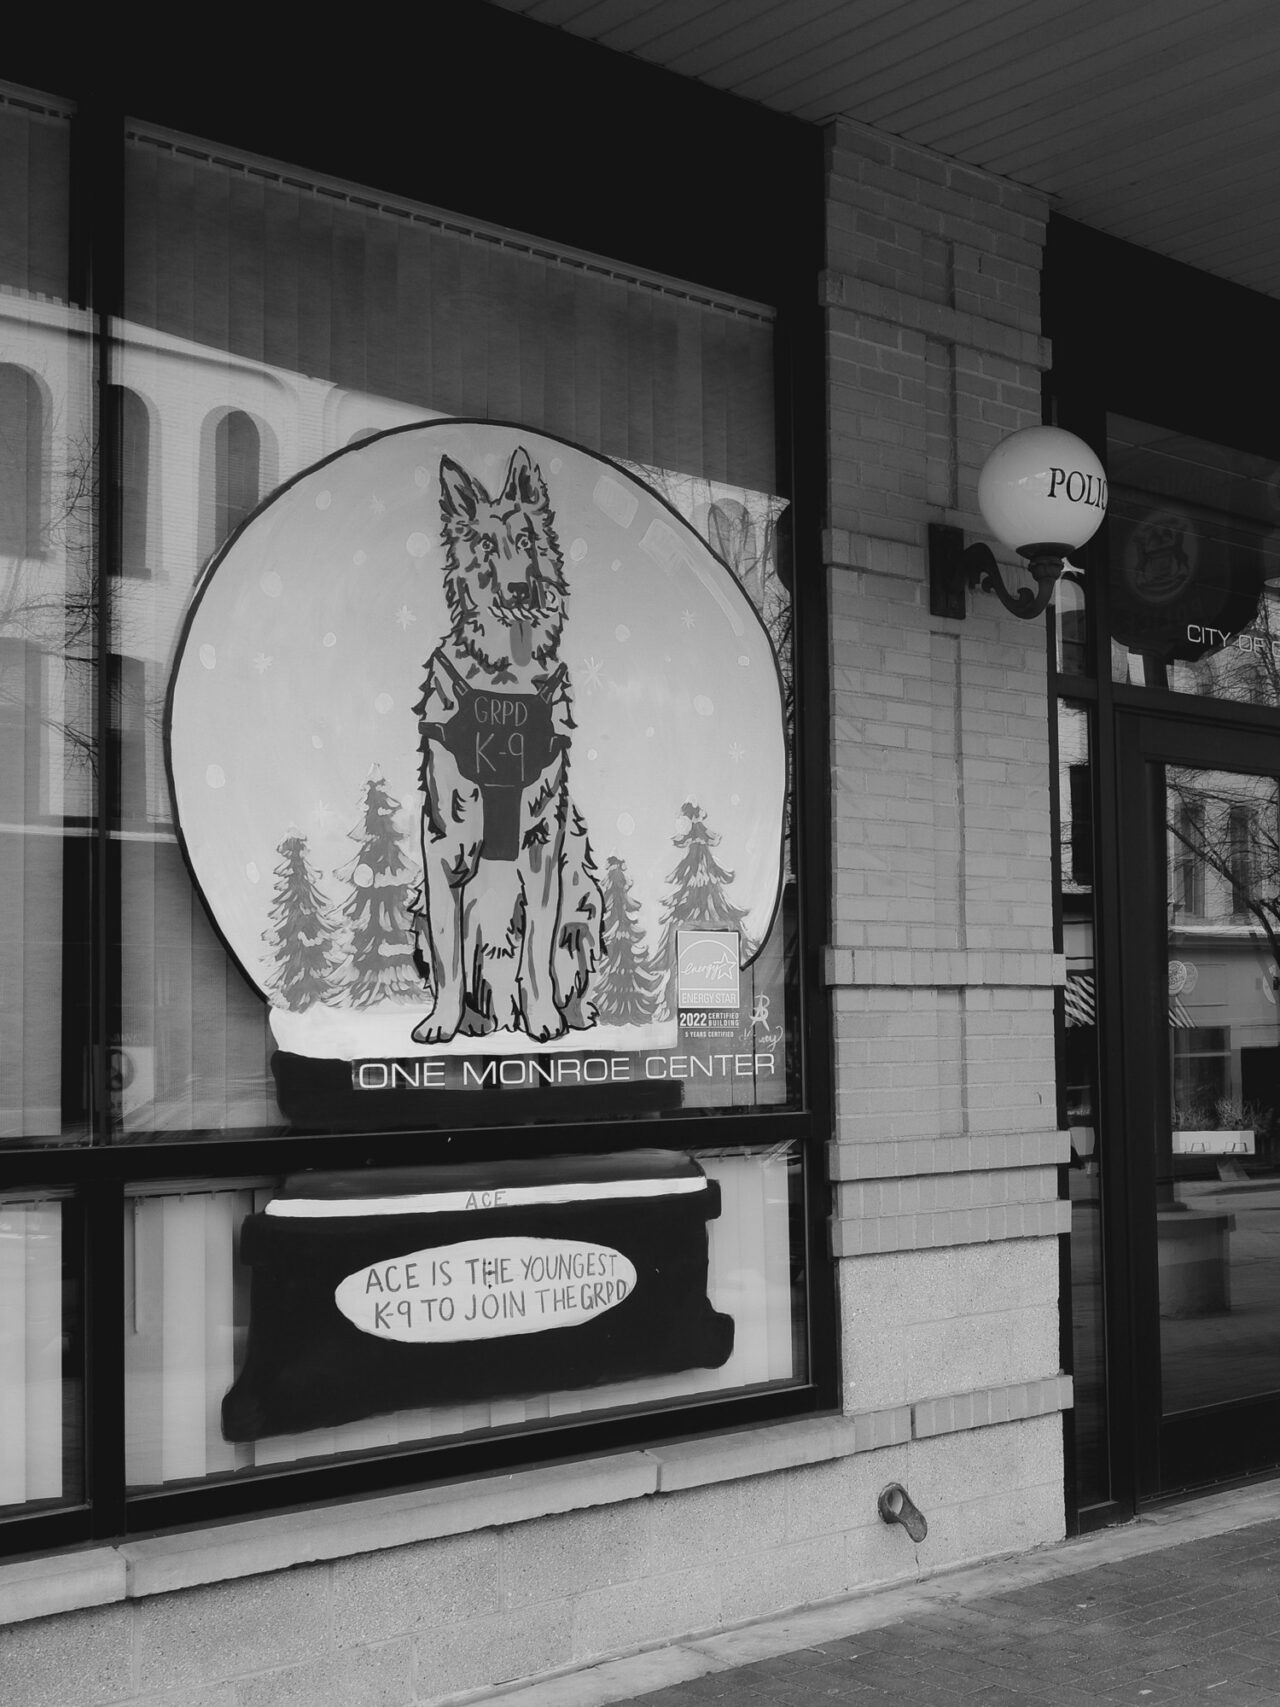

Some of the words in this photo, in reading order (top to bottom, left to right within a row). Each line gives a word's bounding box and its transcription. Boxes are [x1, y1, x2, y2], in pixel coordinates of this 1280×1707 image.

[1187, 624, 1231, 647] CITY
[1238, 634, 1265, 653] OF
[474, 696, 528, 727] GRPD
[475, 732, 525, 782] K-9
[681, 992, 716, 1004] ENERGY
[716, 992, 737, 1004] STAR
[680, 1012, 708, 1027] 2022
[708, 1012, 740, 1020] CERTIFIED
[708, 1019, 740, 1027] BUILDING
[359, 1062, 445, 1088] ONE
[463, 1057, 630, 1086] MONROE
[645, 1053, 775, 1079] CENTER
[465, 1190, 508, 1209] ACE
[365, 1263, 420, 1294] ACE
[432, 1260, 453, 1286] IS
[465, 1257, 514, 1286] THE
[520, 1252, 618, 1282] YOUNGEST
[374, 1301, 412, 1329] K-9
[420, 1296, 455, 1322] TO
[464, 1290, 526, 1321] JOIN
[535, 1285, 578, 1314] THE
[580, 1278, 628, 1310] GRPD
